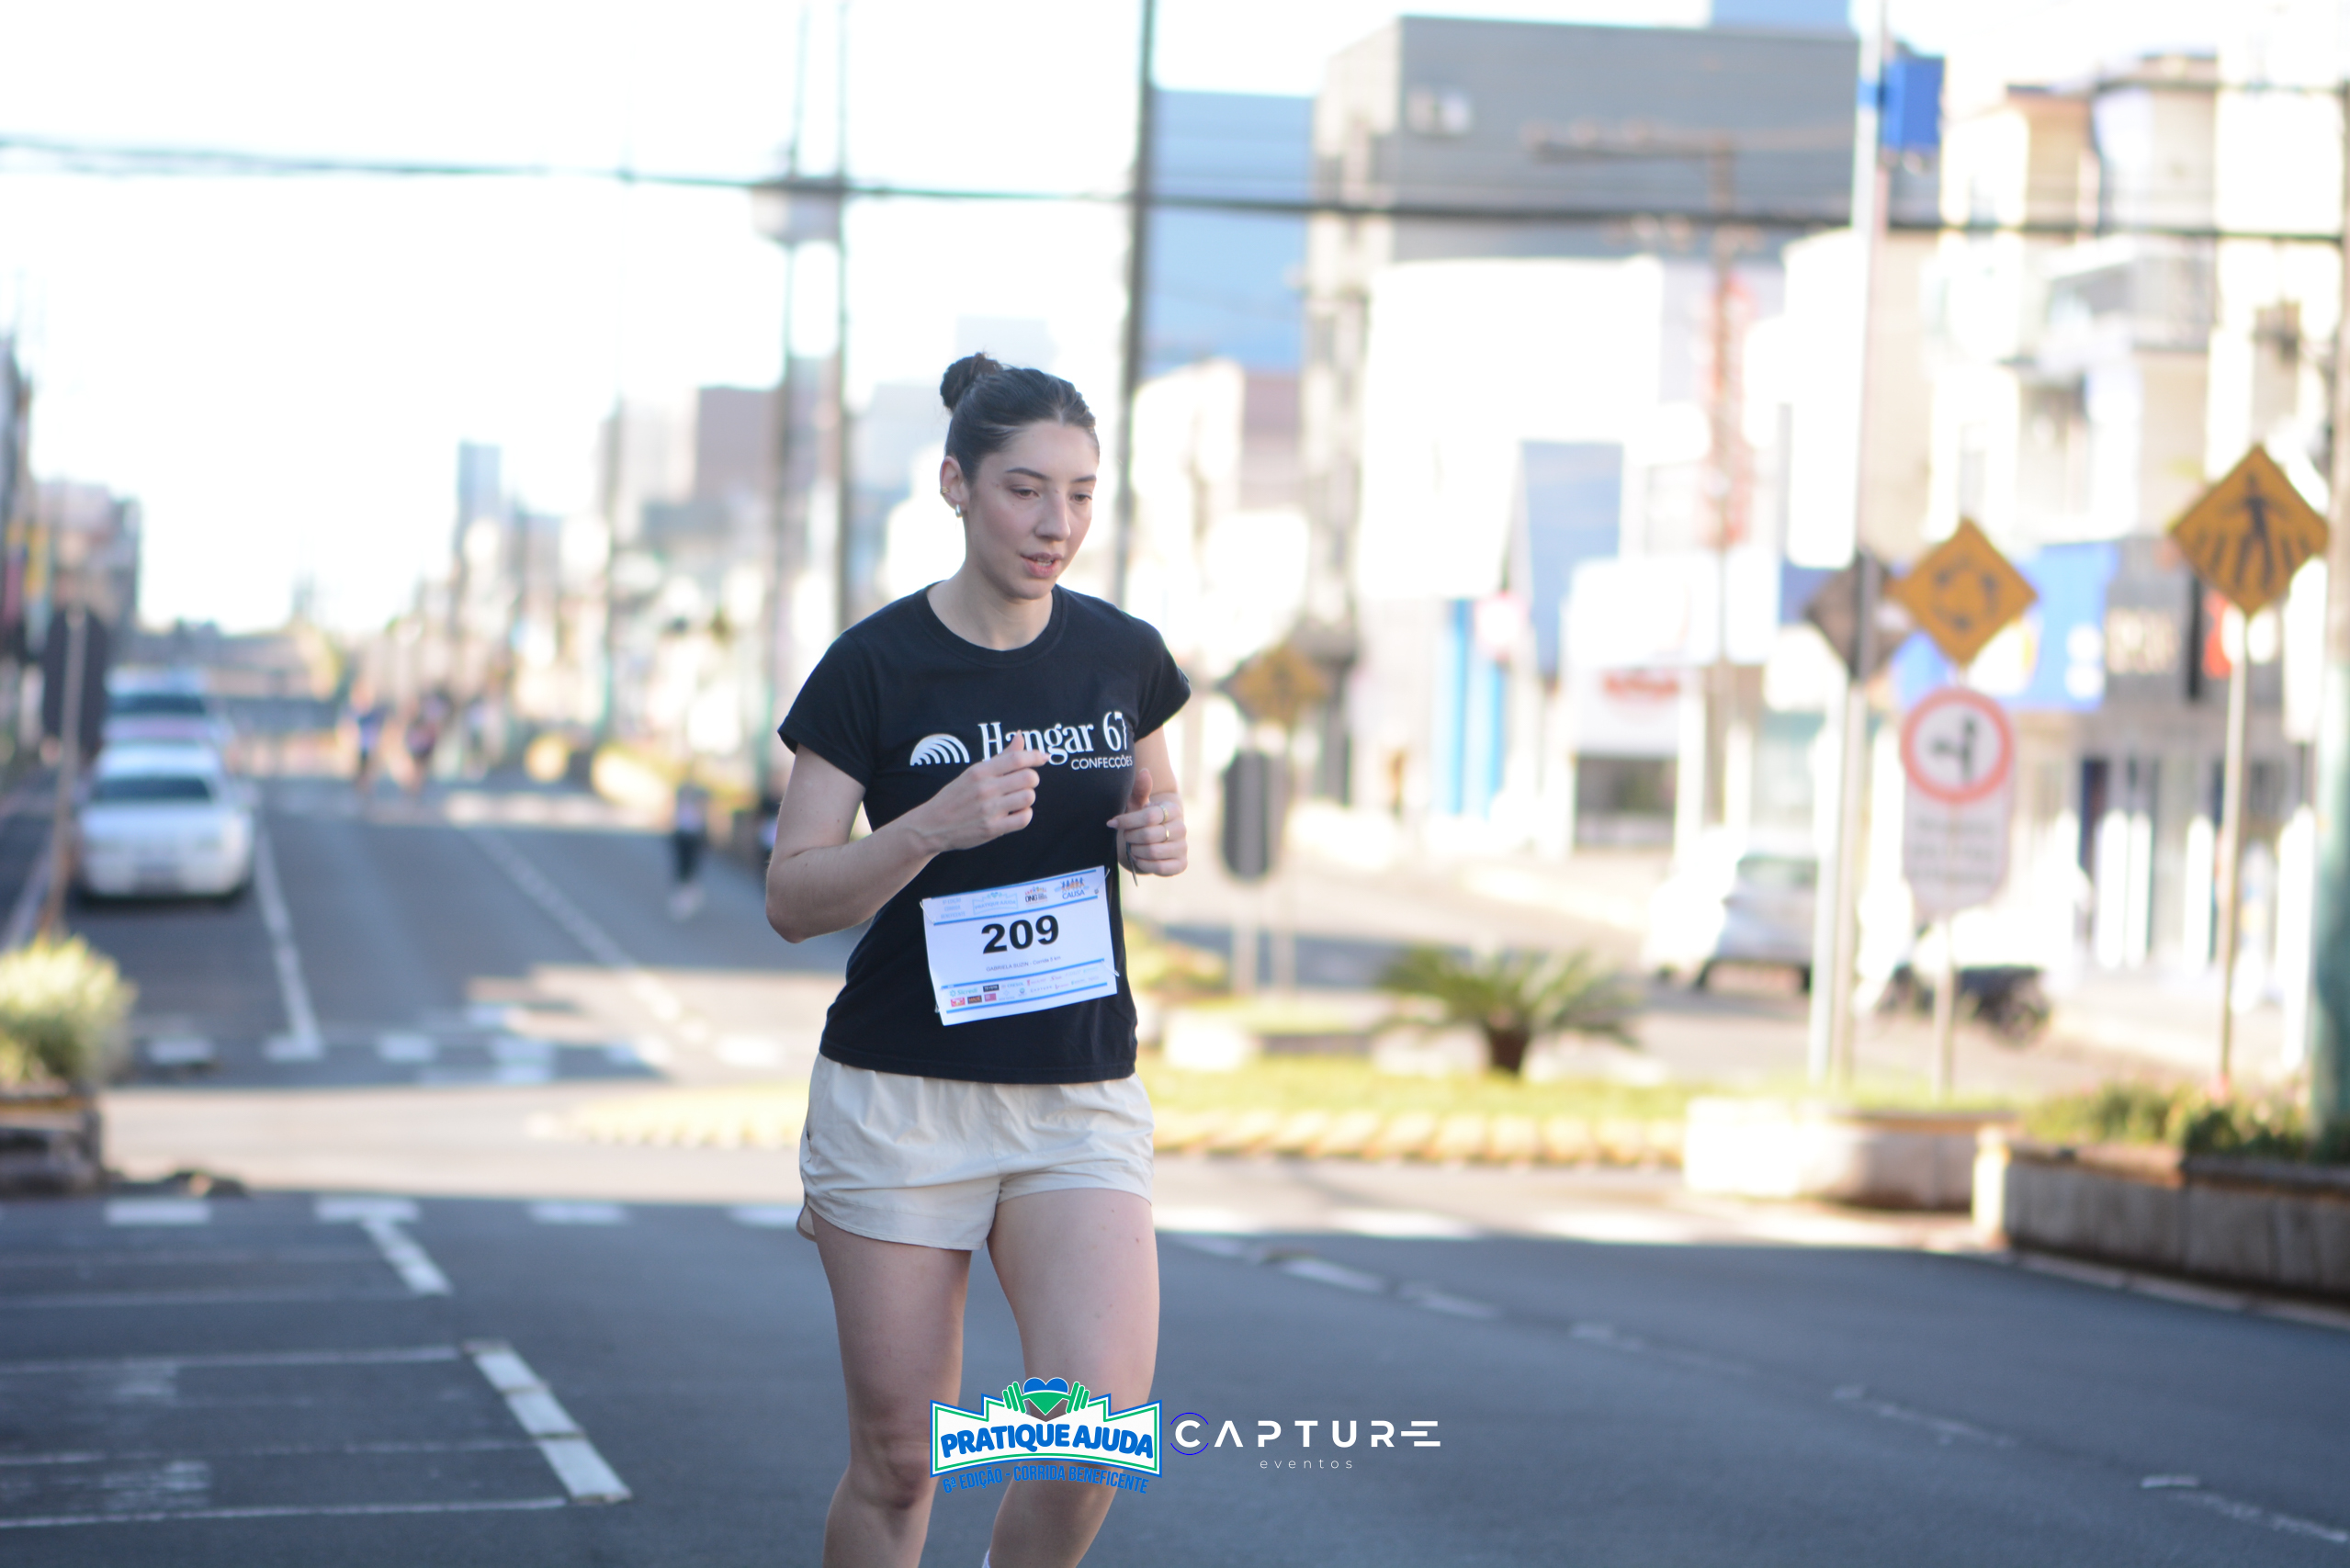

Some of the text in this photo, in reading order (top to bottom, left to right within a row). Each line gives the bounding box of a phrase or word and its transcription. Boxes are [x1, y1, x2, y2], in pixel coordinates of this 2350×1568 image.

[1071, 755, 1133, 771] CONFECÇÕES
[1024, 894, 1038, 903] ONG
[1062, 889, 1085, 899] CAUSA
[975, 901, 1000, 910] PRATIQUE
[981, 915, 1059, 954] 209
[986, 964, 1012, 972] GABRIELA
